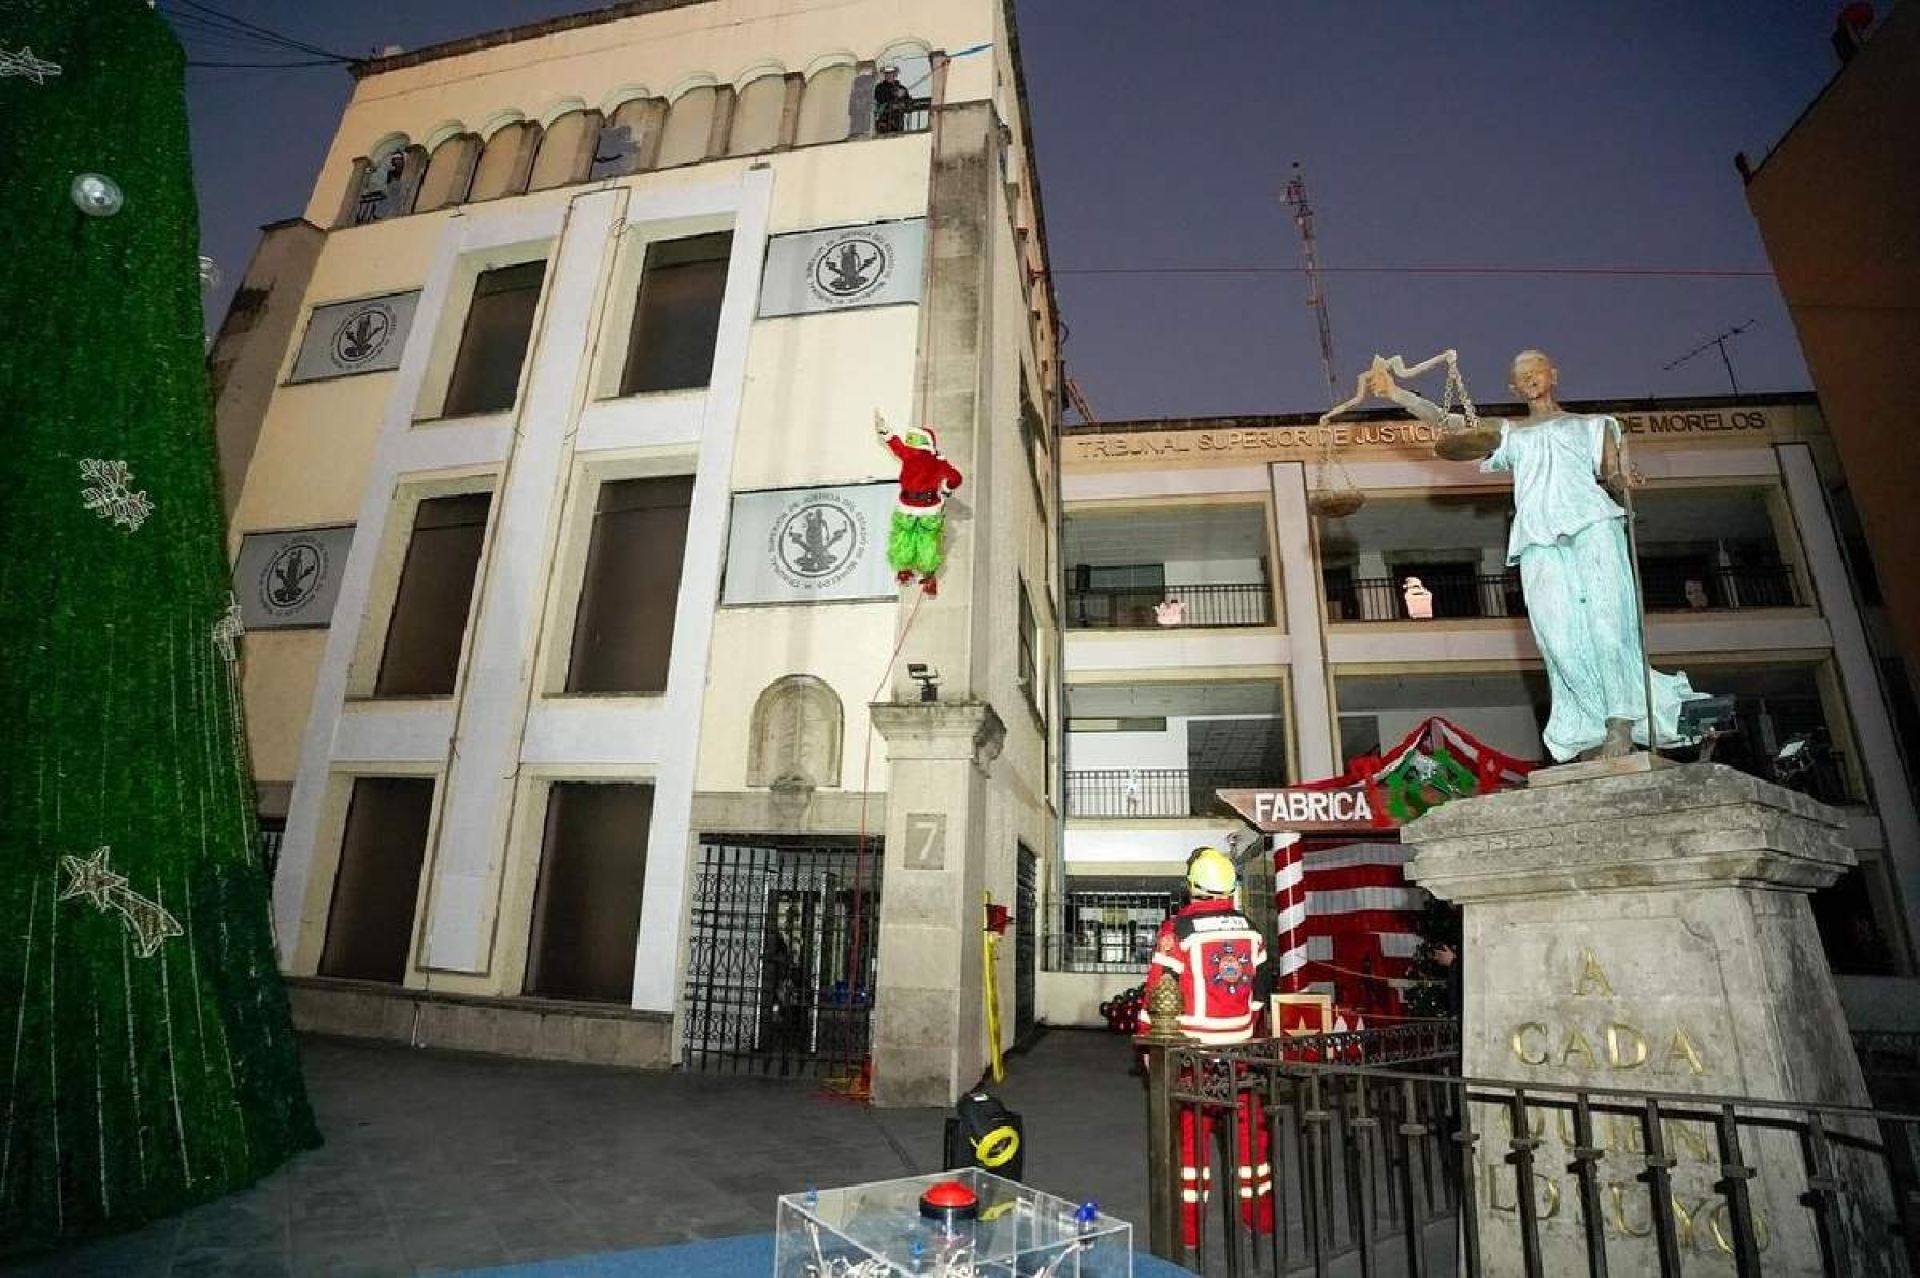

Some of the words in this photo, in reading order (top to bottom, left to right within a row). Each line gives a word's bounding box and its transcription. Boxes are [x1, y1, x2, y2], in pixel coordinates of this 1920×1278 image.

[1077, 437, 1191, 458] TRIBUNAL
[1199, 429, 1313, 451] SUPERIOR
[1318, 426, 1348, 447] DE
[1650, 412, 1767, 433] MORELOS
[1255, 791, 1374, 823] FABRICA
[914, 821, 937, 860] 7
[1573, 947, 1615, 999] A
[1511, 1021, 1709, 1076] CADA
[1576, 1177, 1770, 1254] UYO
